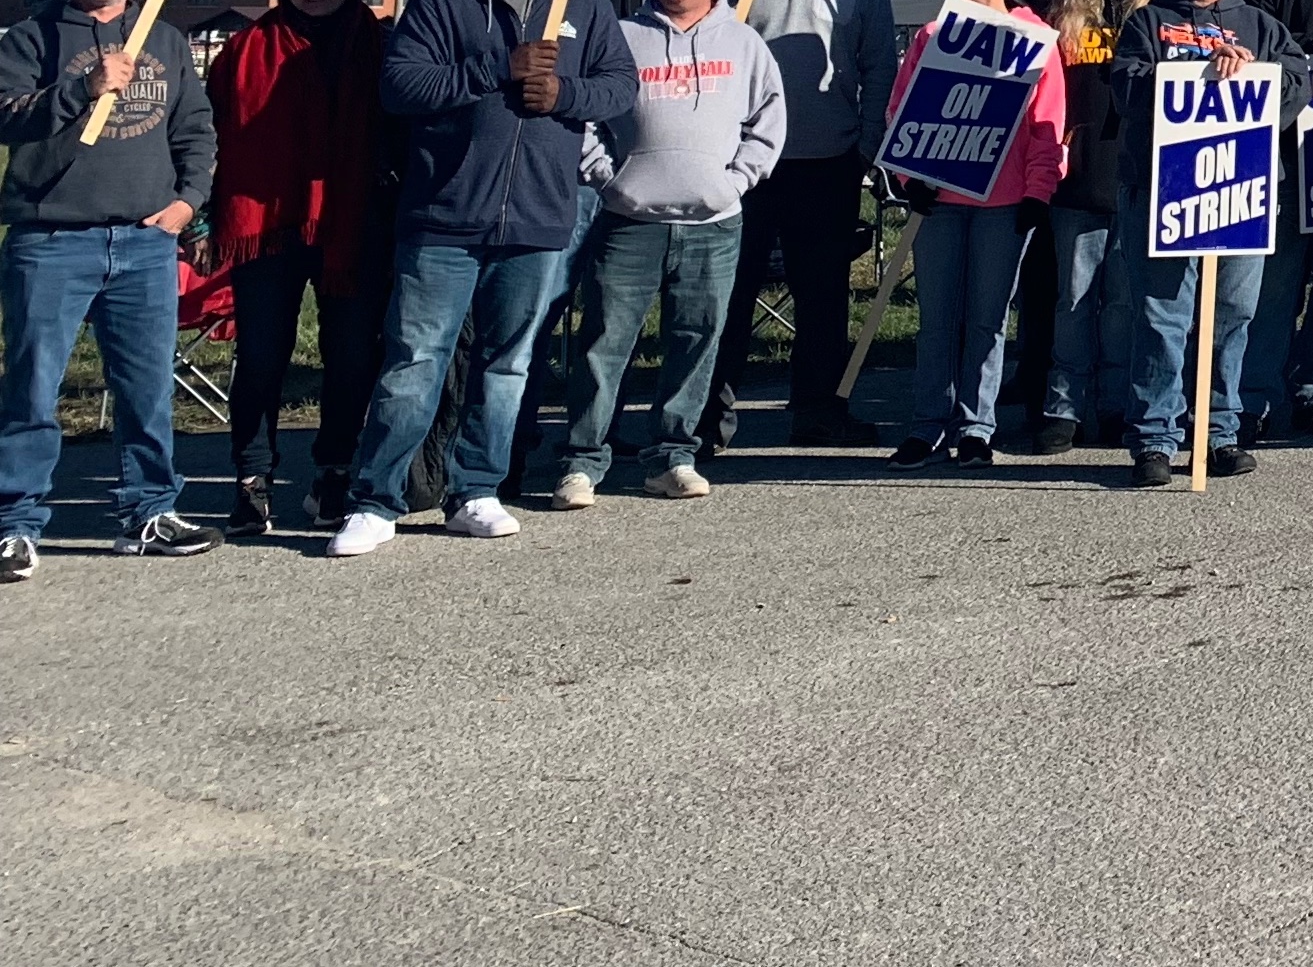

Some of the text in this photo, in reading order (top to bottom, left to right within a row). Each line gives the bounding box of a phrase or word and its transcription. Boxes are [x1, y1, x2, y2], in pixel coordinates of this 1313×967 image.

[937, 10, 1044, 78] UAW
[121, 82, 167, 103] QUALITY
[941, 82, 985, 118] ON
[1163, 80, 1270, 125] UAW
[891, 120, 1005, 163] STRIKE
[1194, 142, 1236, 191] ON
[1161, 178, 1266, 244] STRIKE
